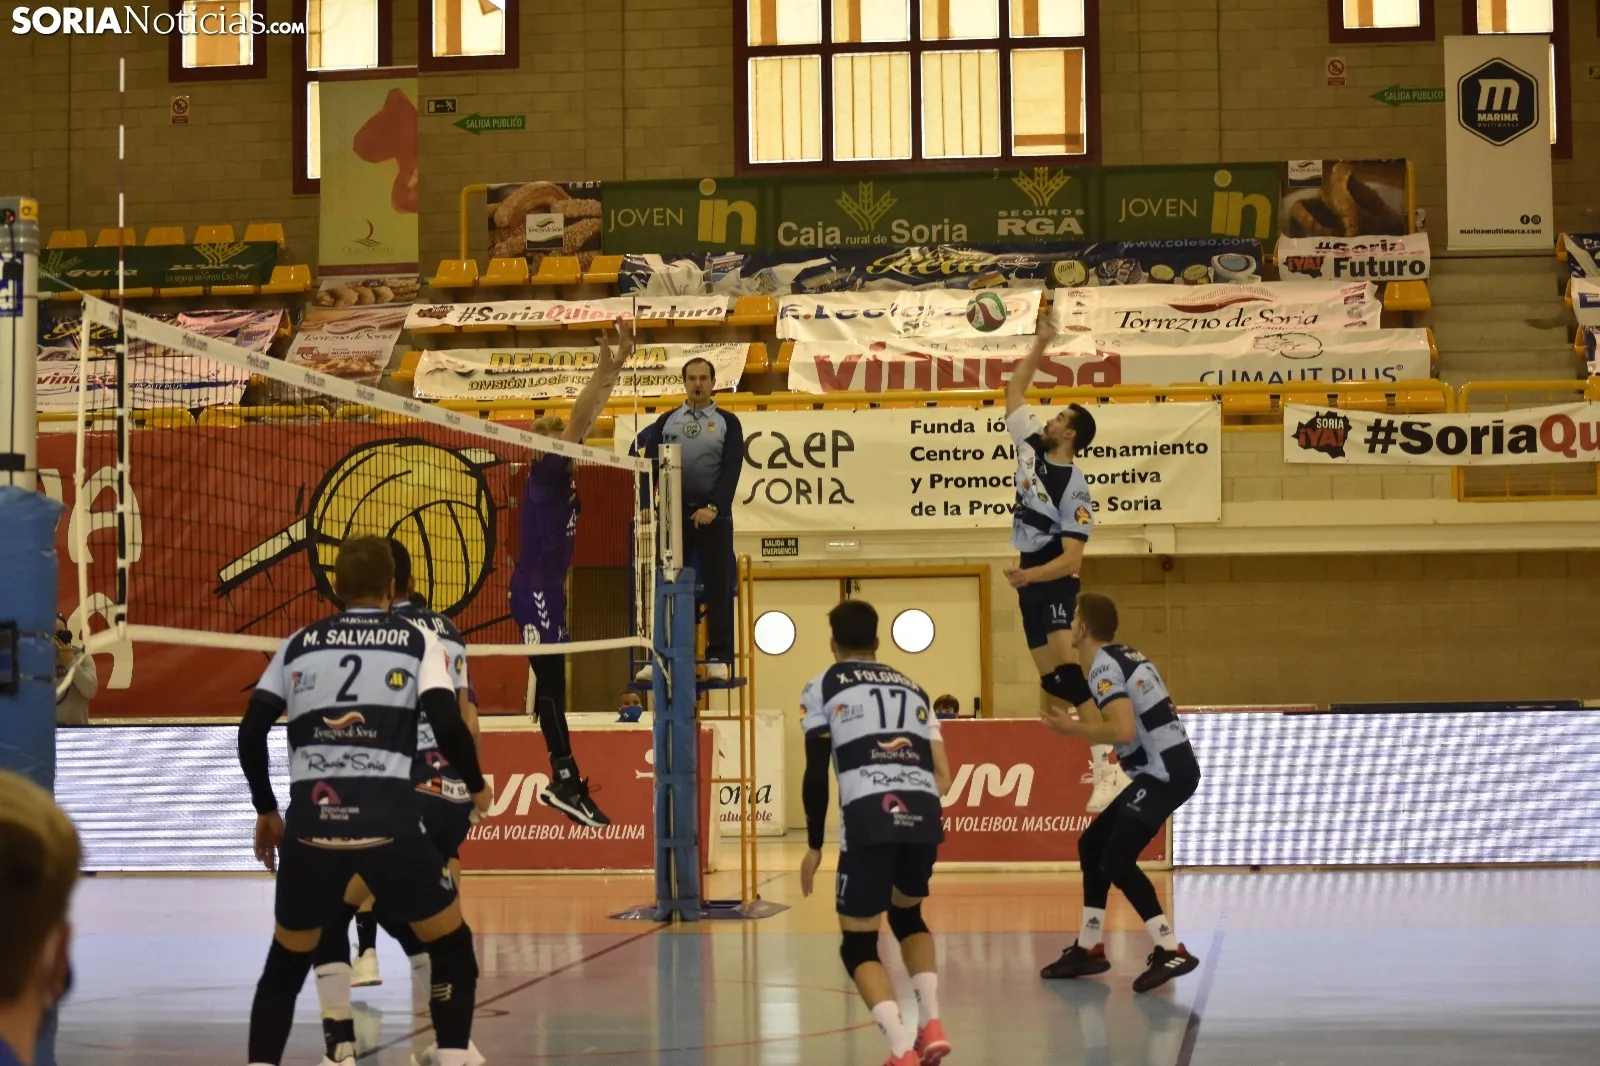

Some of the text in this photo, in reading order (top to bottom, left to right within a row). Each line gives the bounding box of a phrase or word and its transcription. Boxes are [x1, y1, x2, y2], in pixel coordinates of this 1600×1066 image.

[1384, 90, 1444, 101] SALIDA PUBLICO
[466, 118, 491, 128] SALIDA
[1477, 113, 1519, 122] MARINA
[608, 178, 757, 245] JOVEN in
[998, 208, 1085, 217] SEGUROS
[1119, 169, 1272, 239] JOVEN in
[778, 218, 968, 249] Caja rural de Soria
[997, 217, 1084, 236] RGA
[1459, 227, 1542, 236] marinamultimarca.com
[1333, 256, 1426, 278] Futuro
[1114, 309, 1221, 334] Torrezno
[1225, 307, 1253, 328] de
[1255, 307, 1319, 328] Soria
[489, 346, 668, 368] DEPORMA
[468, 376, 527, 391] DIVISIÓN
[528, 373, 591, 389] LOGÍSTIC
[622, 373, 684, 387] EVENTOS
[1316, 417, 1345, 430] SORIA
[1298, 427, 1345, 447] ¡YA!
[910, 446, 985, 462] Centro
[910, 476, 923, 494] y
[910, 500, 937, 517] de
[943, 500, 961, 516] la
[1107, 496, 1162, 512] Soria
[762, 547, 797, 556] EMERGENCIA
[764, 539, 796, 548] SALIDA DE
[1050, 603, 1067, 619] 14
[432, 617, 450, 635] JR.
[303, 628, 410, 648] M. SALVADOR
[336, 653, 363, 703] 2
[836, 672, 854, 685] X.
[869, 687, 907, 729] 17
[719, 783, 773, 806] oria
[1135, 788, 1147, 804] 9
[503, 824, 566, 841] VOLEIBOL
[568, 823, 646, 840] MASCULINA
[955, 815, 1019, 832] VOLEIBOL
[1021, 815, 1092, 832] MASCULIN
